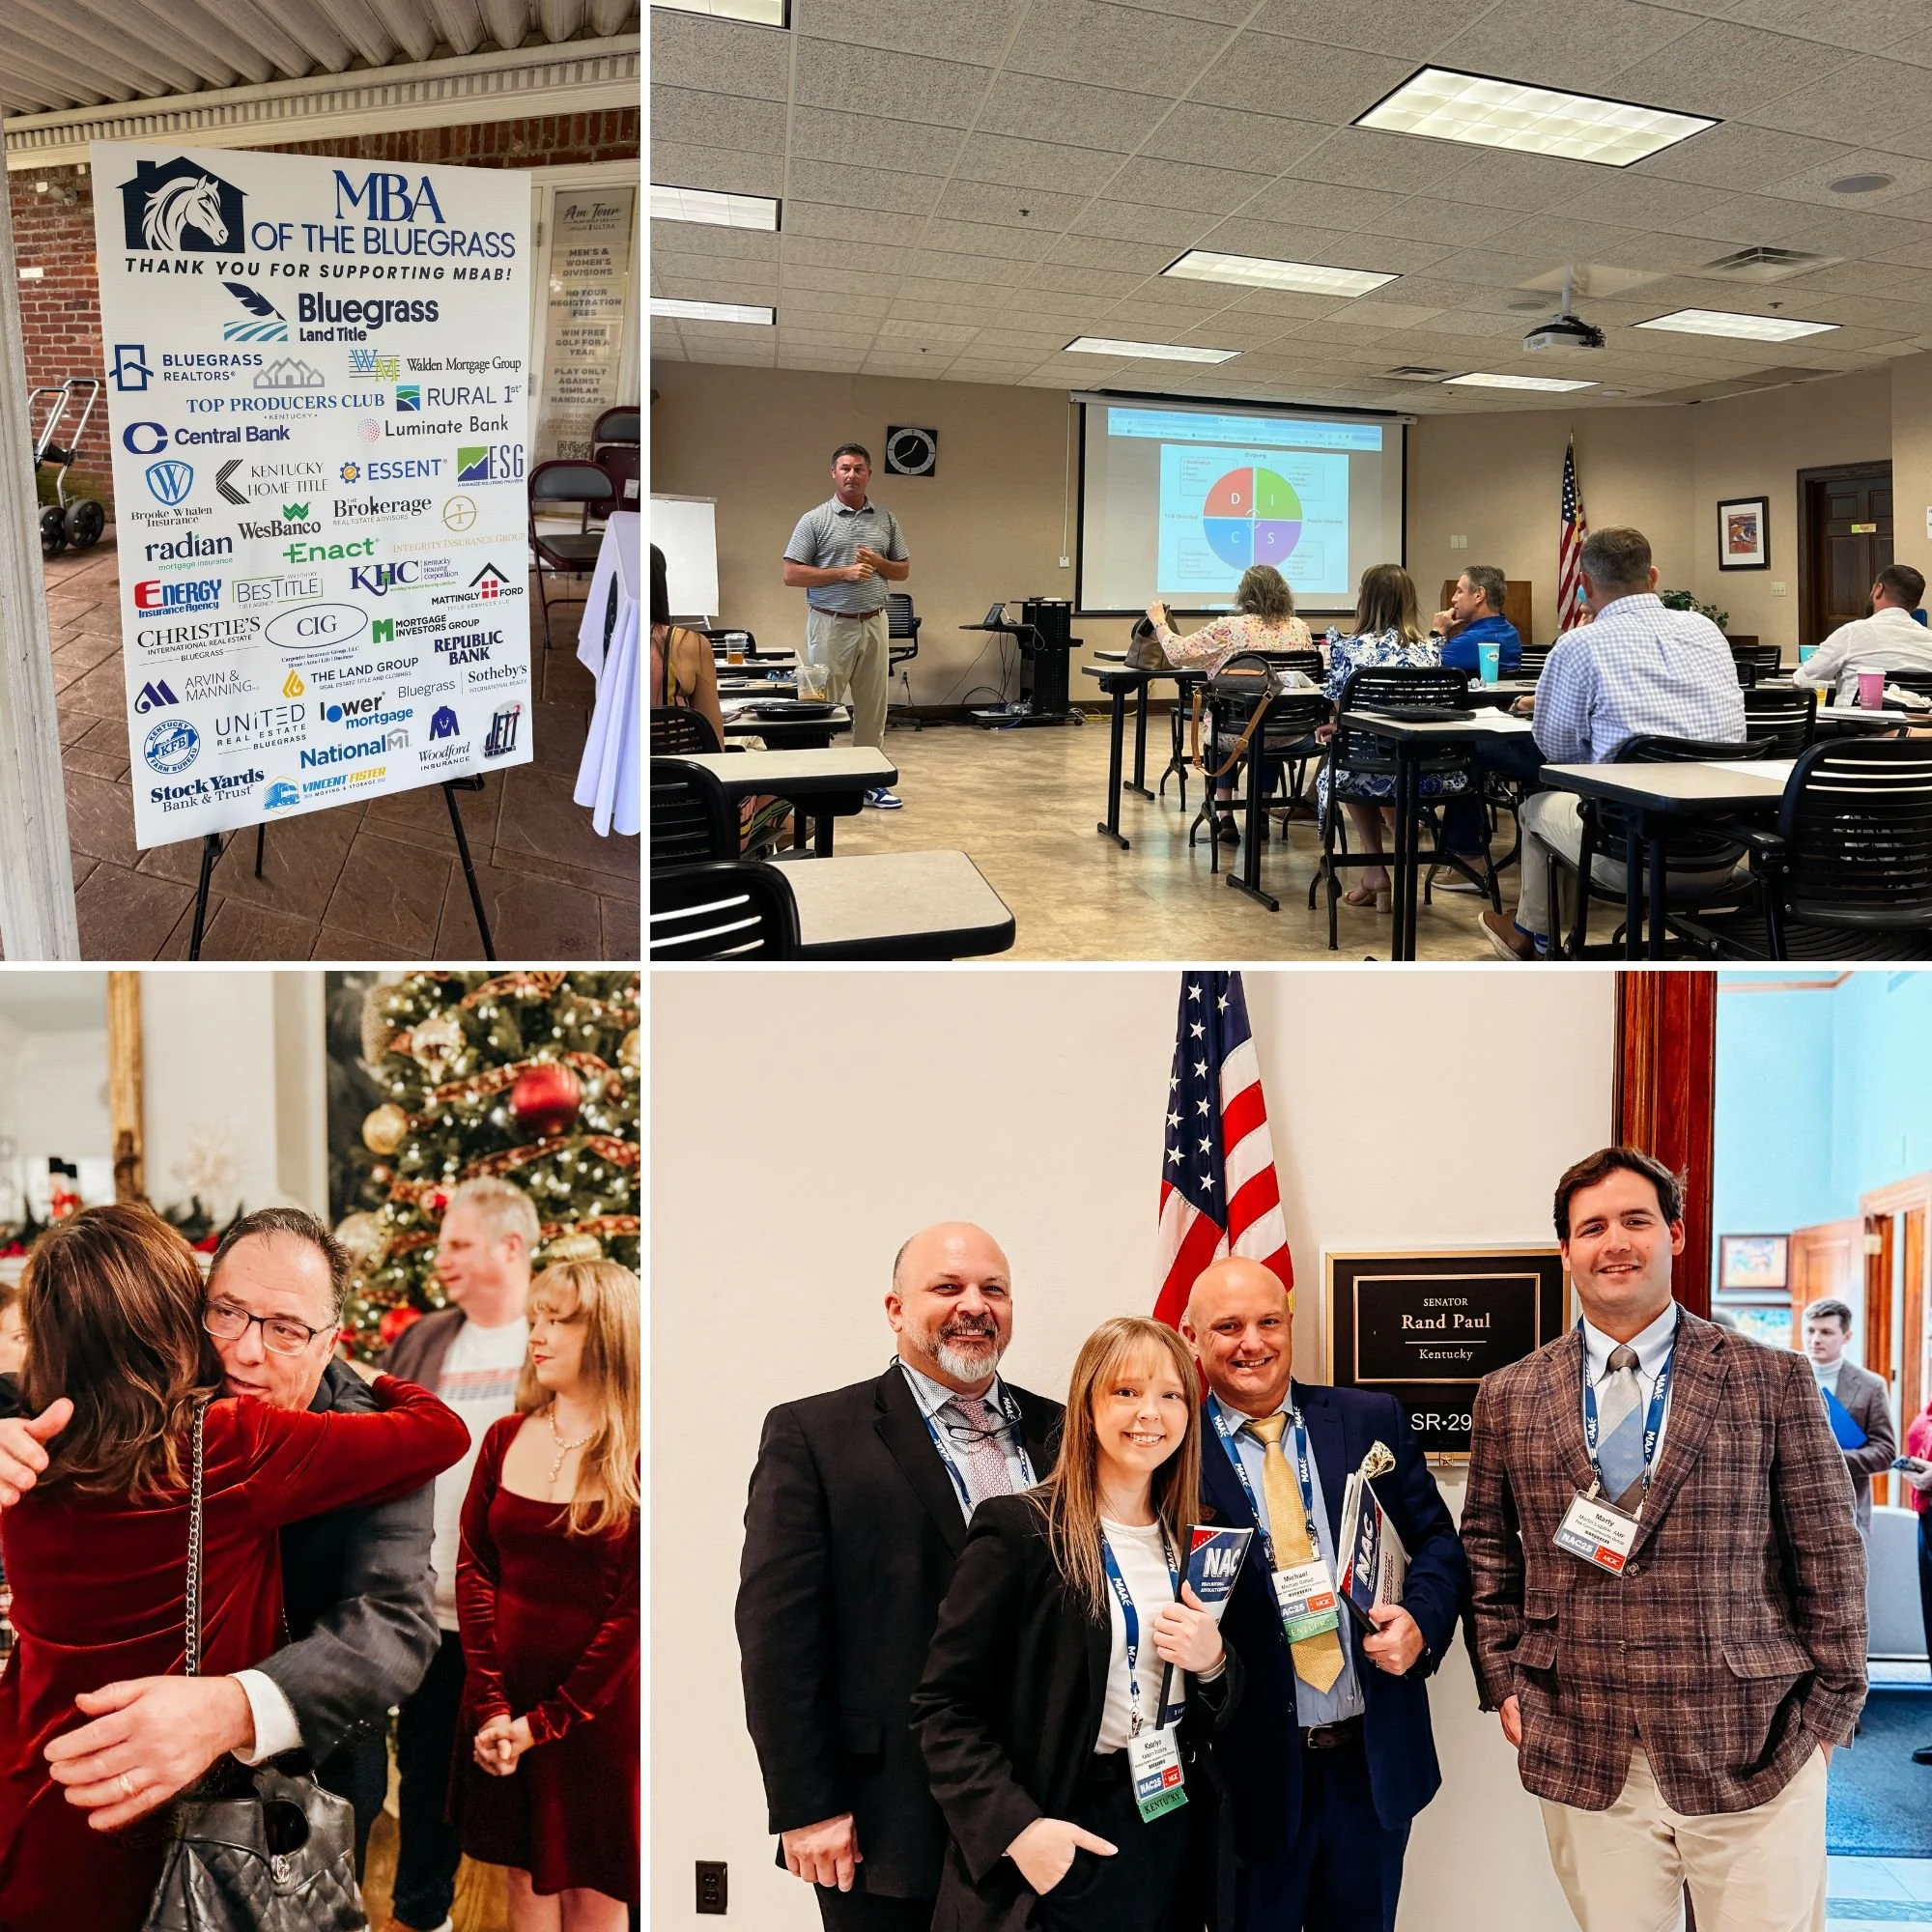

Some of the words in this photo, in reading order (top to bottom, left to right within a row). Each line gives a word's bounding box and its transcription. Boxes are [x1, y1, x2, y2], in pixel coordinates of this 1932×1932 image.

[332, 170, 445, 223] MBA
[251, 222, 294, 252] OF
[300, 223, 355, 254] THE
[363, 226, 516, 258] BLUEGRASS
[569, 248, 599, 257] MEN'S
[125, 258, 205, 274] THANK
[216, 261, 261, 276] YOU
[270, 263, 310, 278] FOR
[320, 264, 444, 280] SUPPORTING
[453, 267, 512, 281] MBAB!
[298, 292, 439, 329] Bluegrass
[551, 298, 621, 307] REGISTRATION
[299, 327, 333, 342] Land
[337, 327, 367, 342] Title
[162, 354, 263, 367] BLUEGRASS
[407, 357, 442, 372] Walden
[446, 357, 491, 375] Mortgage
[493, 355, 522, 372] Group
[186, 398, 225, 413] TOP
[231, 396, 337, 412] PRODUCERS
[342, 394, 385, 408] CLUB
[427, 386, 497, 407] RURAL
[174, 427, 242, 445] Central
[245, 425, 290, 442] Bank
[384, 420, 463, 437] Luminate
[469, 413, 508, 433] Bank
[251, 462, 325, 478] KENTUCKY
[490, 444, 524, 479] ESG
[248, 481, 291, 497] HOME
[296, 479, 328, 493] TITLE
[332, 496, 432, 518] Brokerage
[1231, 493, 1240, 504] D
[131, 510, 169, 522] Brooke
[173, 506, 213, 518] Whalen
[147, 516, 199, 527] Insurance
[377, 514, 408, 523] ADVISORS
[238, 520, 321, 540] WesBanco
[1231, 531, 1240, 543] C
[1267, 532, 1275, 545] S
[145, 531, 233, 561] radian
[393, 541, 442, 553] INTEGRITY
[443, 537, 495, 549] INSURANCE
[497, 533, 526, 543] GROUP
[158, 560, 196, 571] mortgage
[197, 556, 233, 567] insurance
[423, 556, 450, 566] Kentucky
[349, 560, 419, 597] KHC
[431, 591, 480, 605] MATTINGLY
[499, 587, 524, 597] FORD
[468, 601, 497, 611] SERVICES
[139, 605, 185, 618] Insurance
[185, 603, 219, 615] Agency
[298, 614, 337, 637] CIG
[396, 614, 446, 628] MORTGAGE
[396, 623, 446, 638] INVESTORS
[448, 618, 479, 630] GROUP
[137, 616, 261, 647] CHRISTIE'S
[435, 630, 504, 653] REPUBLIC
[147, 640, 207, 655] INTERNATIONAL
[209, 638, 227, 646] REAL
[228, 634, 252, 643] ESTATE
[181, 649, 224, 662] BLUEGRASS
[448, 647, 491, 666] BANK
[185, 672, 224, 690] ARVIN
[230, 670, 240, 682] &
[311, 668, 335, 684] THE
[340, 664, 373, 678] LAND
[377, 657, 419, 672] GROUP
[385, 670, 412, 680] CLOSINGS
[186, 680, 251, 701] MANNING
[398, 681, 456, 698] Bluegrass
[468, 664, 527, 684] Sotheby's
[469, 683, 508, 694] INTERNATIONAL
[319, 697, 383, 723] lower
[346, 707, 413, 730] mortgage
[149, 721, 189, 742] KENTUCKY
[216, 734, 250, 746] REAL
[259, 724, 306, 738] ESTATE
[485, 711, 520, 751] JETT
[160, 736, 185, 757] KFB
[253, 734, 307, 750] BLUEGRASS
[151, 759, 170, 773] FARM
[172, 748, 197, 771] BUREAU
[419, 742, 470, 763] Woodford
[420, 755, 470, 771] INSURANCE
[151, 779, 209, 803] Stock
[209, 769, 265, 790] Yards
[303, 775, 348, 792] VINCENT
[350, 767, 386, 782] FISTER
[315, 788, 340, 797] MOVING
[350, 779, 376, 789] STORAGE
[162, 798, 197, 812] Bank
[201, 794, 212, 804] &
[214, 786, 251, 801] Trust
[1424, 1298, 1468, 1307] SENATOR
[1401, 1314, 1447, 1329] Rand
[1453, 1312, 1492, 1329] Paul
[1418, 1349, 1473, 1361] Kentucky
[1596, 1513, 1615, 1526] Marty
[1355, 1512, 1374, 1586] NAC
[1561, 1532, 1594, 1553] NAC25
[1203, 1548, 1241, 1577] NAC
[1283, 1571, 1308, 1582] Michael
[1140, 1777, 1161, 1795] NAC25
